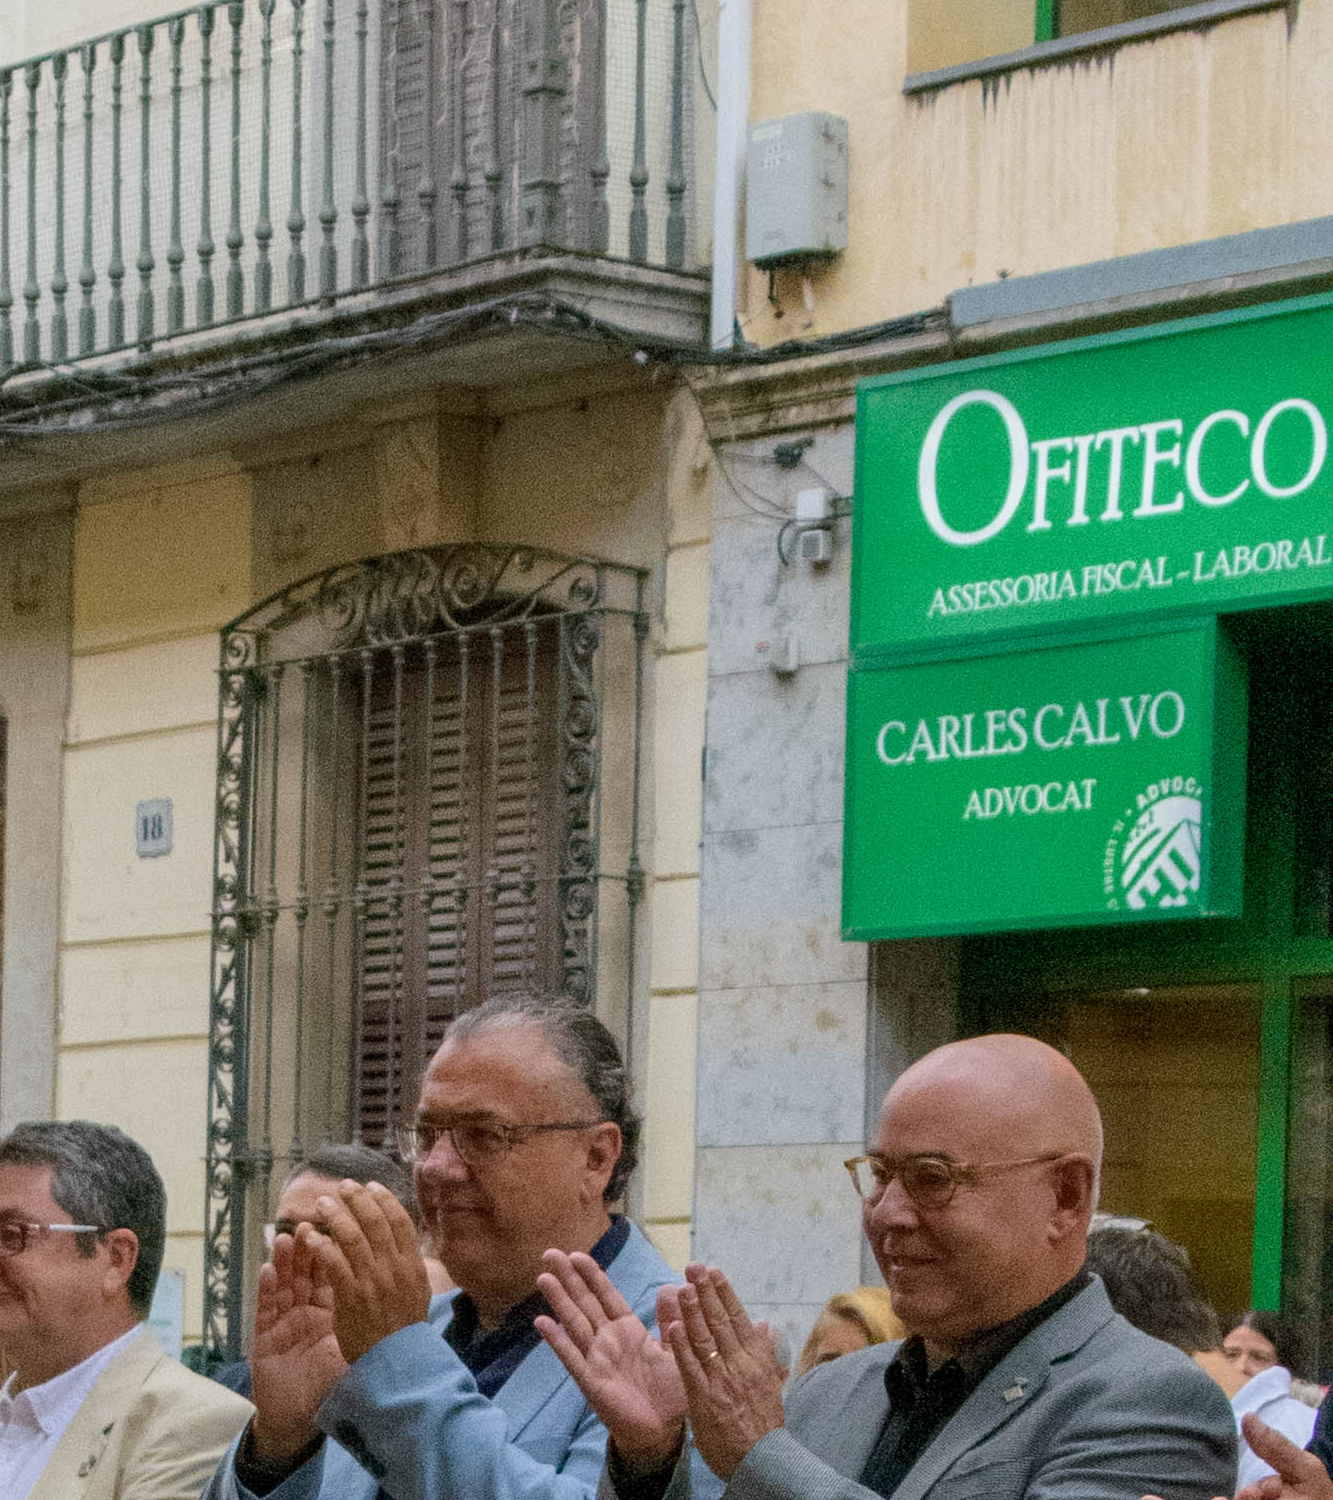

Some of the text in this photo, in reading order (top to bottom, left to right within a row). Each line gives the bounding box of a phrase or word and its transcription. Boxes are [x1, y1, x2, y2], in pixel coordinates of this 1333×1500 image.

[917, 389, 1328, 546] OFITECO
[928, 570, 1078, 616] ASSESSORIA
[1081, 556, 1173, 597] FISCAL
[1193, 534, 1332, 582] LABORAL
[876, 691, 1185, 765] CARLES CALVO
[142, 814, 164, 841] 18
[963, 779, 1097, 819] ADVOCAT
